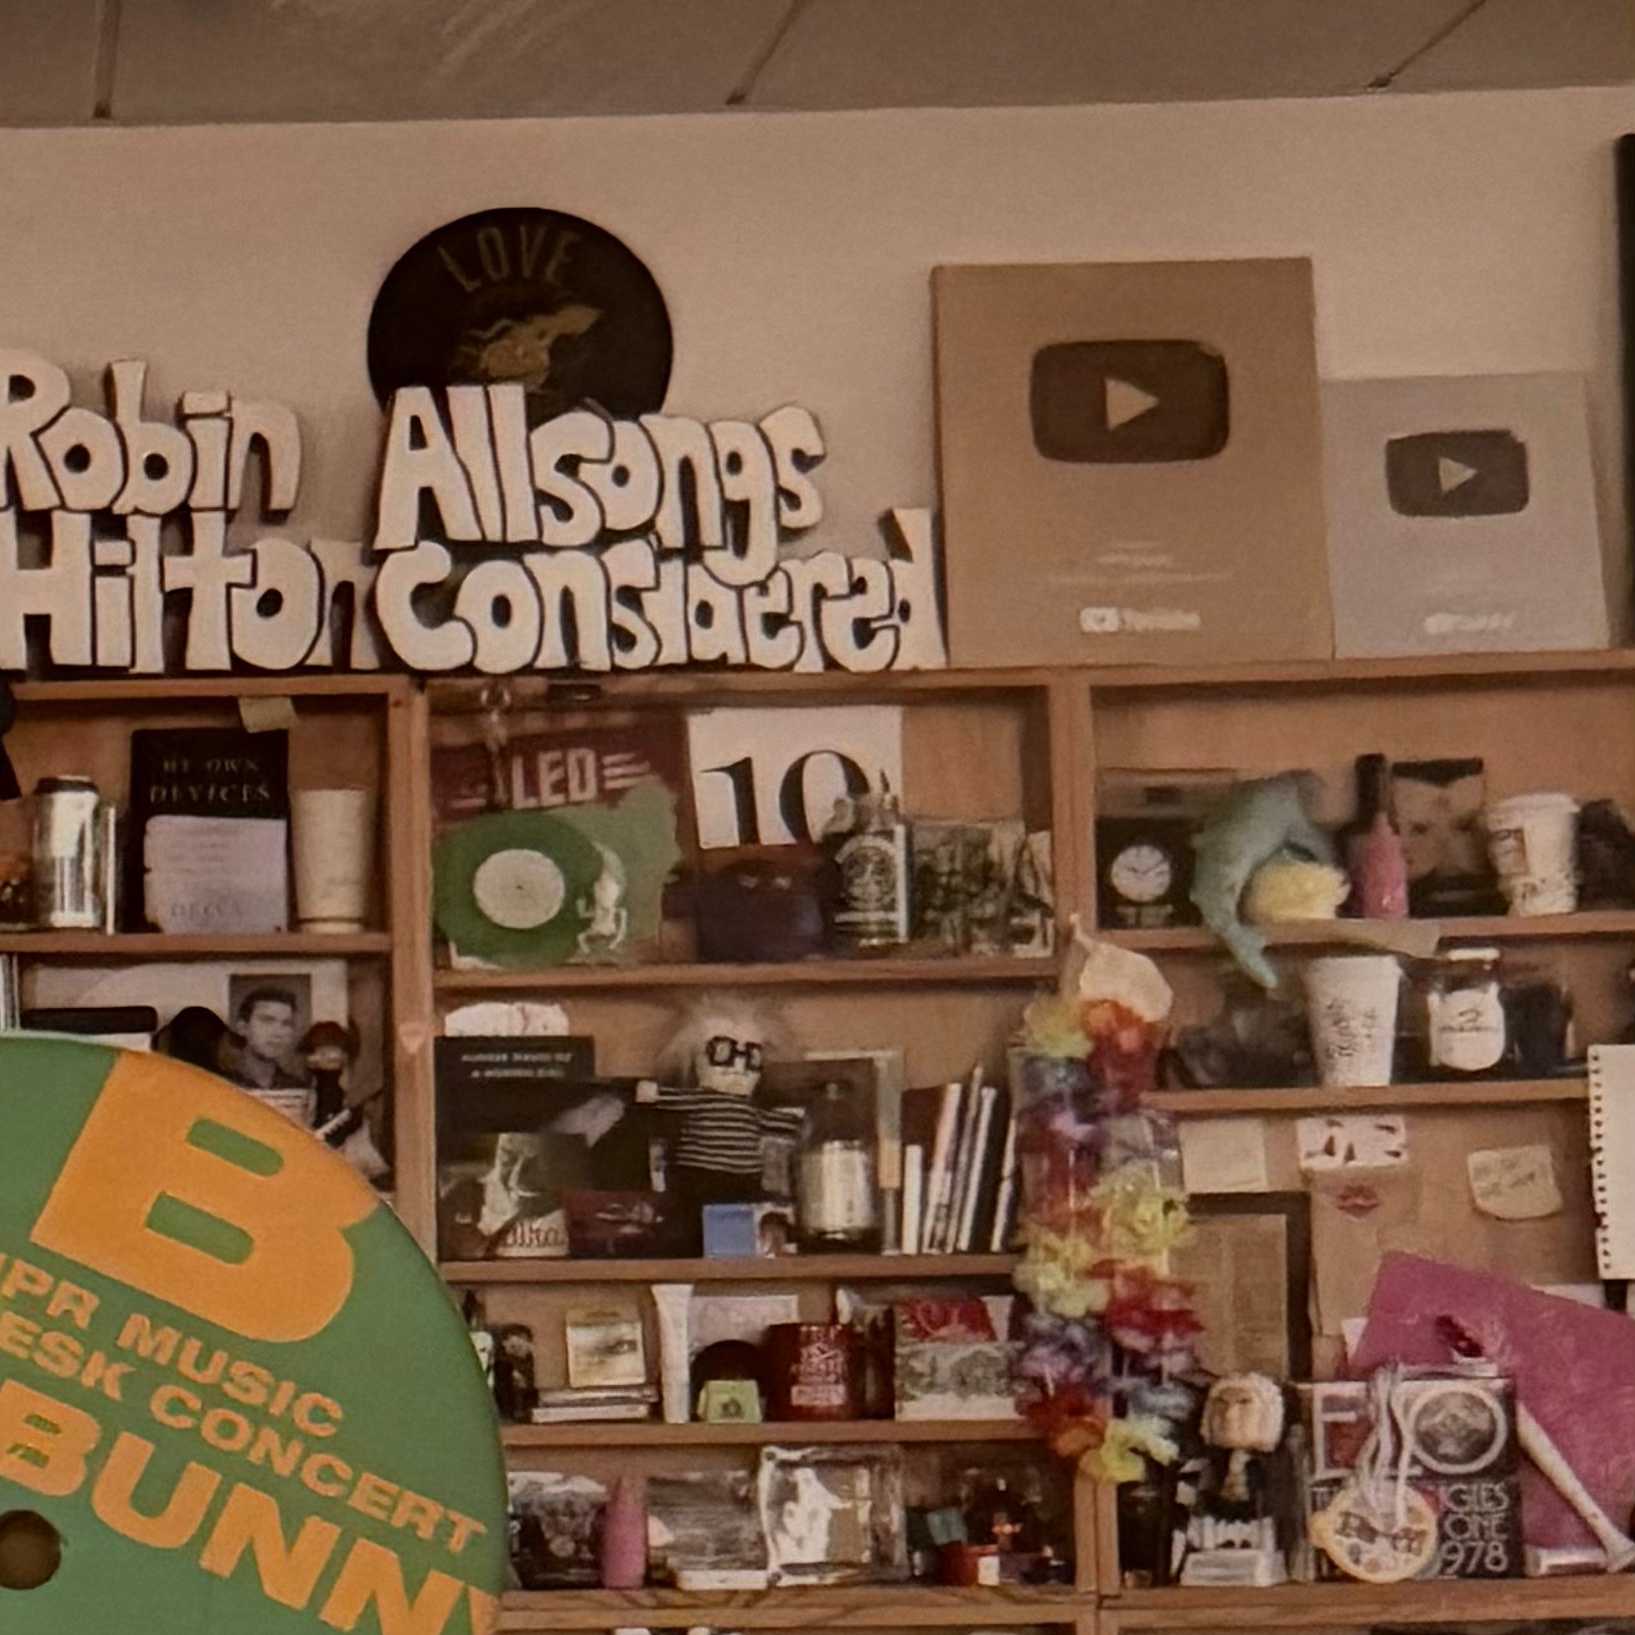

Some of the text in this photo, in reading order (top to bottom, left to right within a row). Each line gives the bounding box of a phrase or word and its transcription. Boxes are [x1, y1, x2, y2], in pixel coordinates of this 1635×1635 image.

[438, 223, 584, 293] LOVE
[371, 382, 827, 588] Allsongs
[698, 748, 873, 849] 10
[29, 1050, 381, 1344] B
[117, 1313, 345, 1438] MUSIC
[148, 1383, 488, 1555] CONCERT
[1443, 1482, 1510, 1514] GLES
[1438, 1541, 1509, 1575] 978
